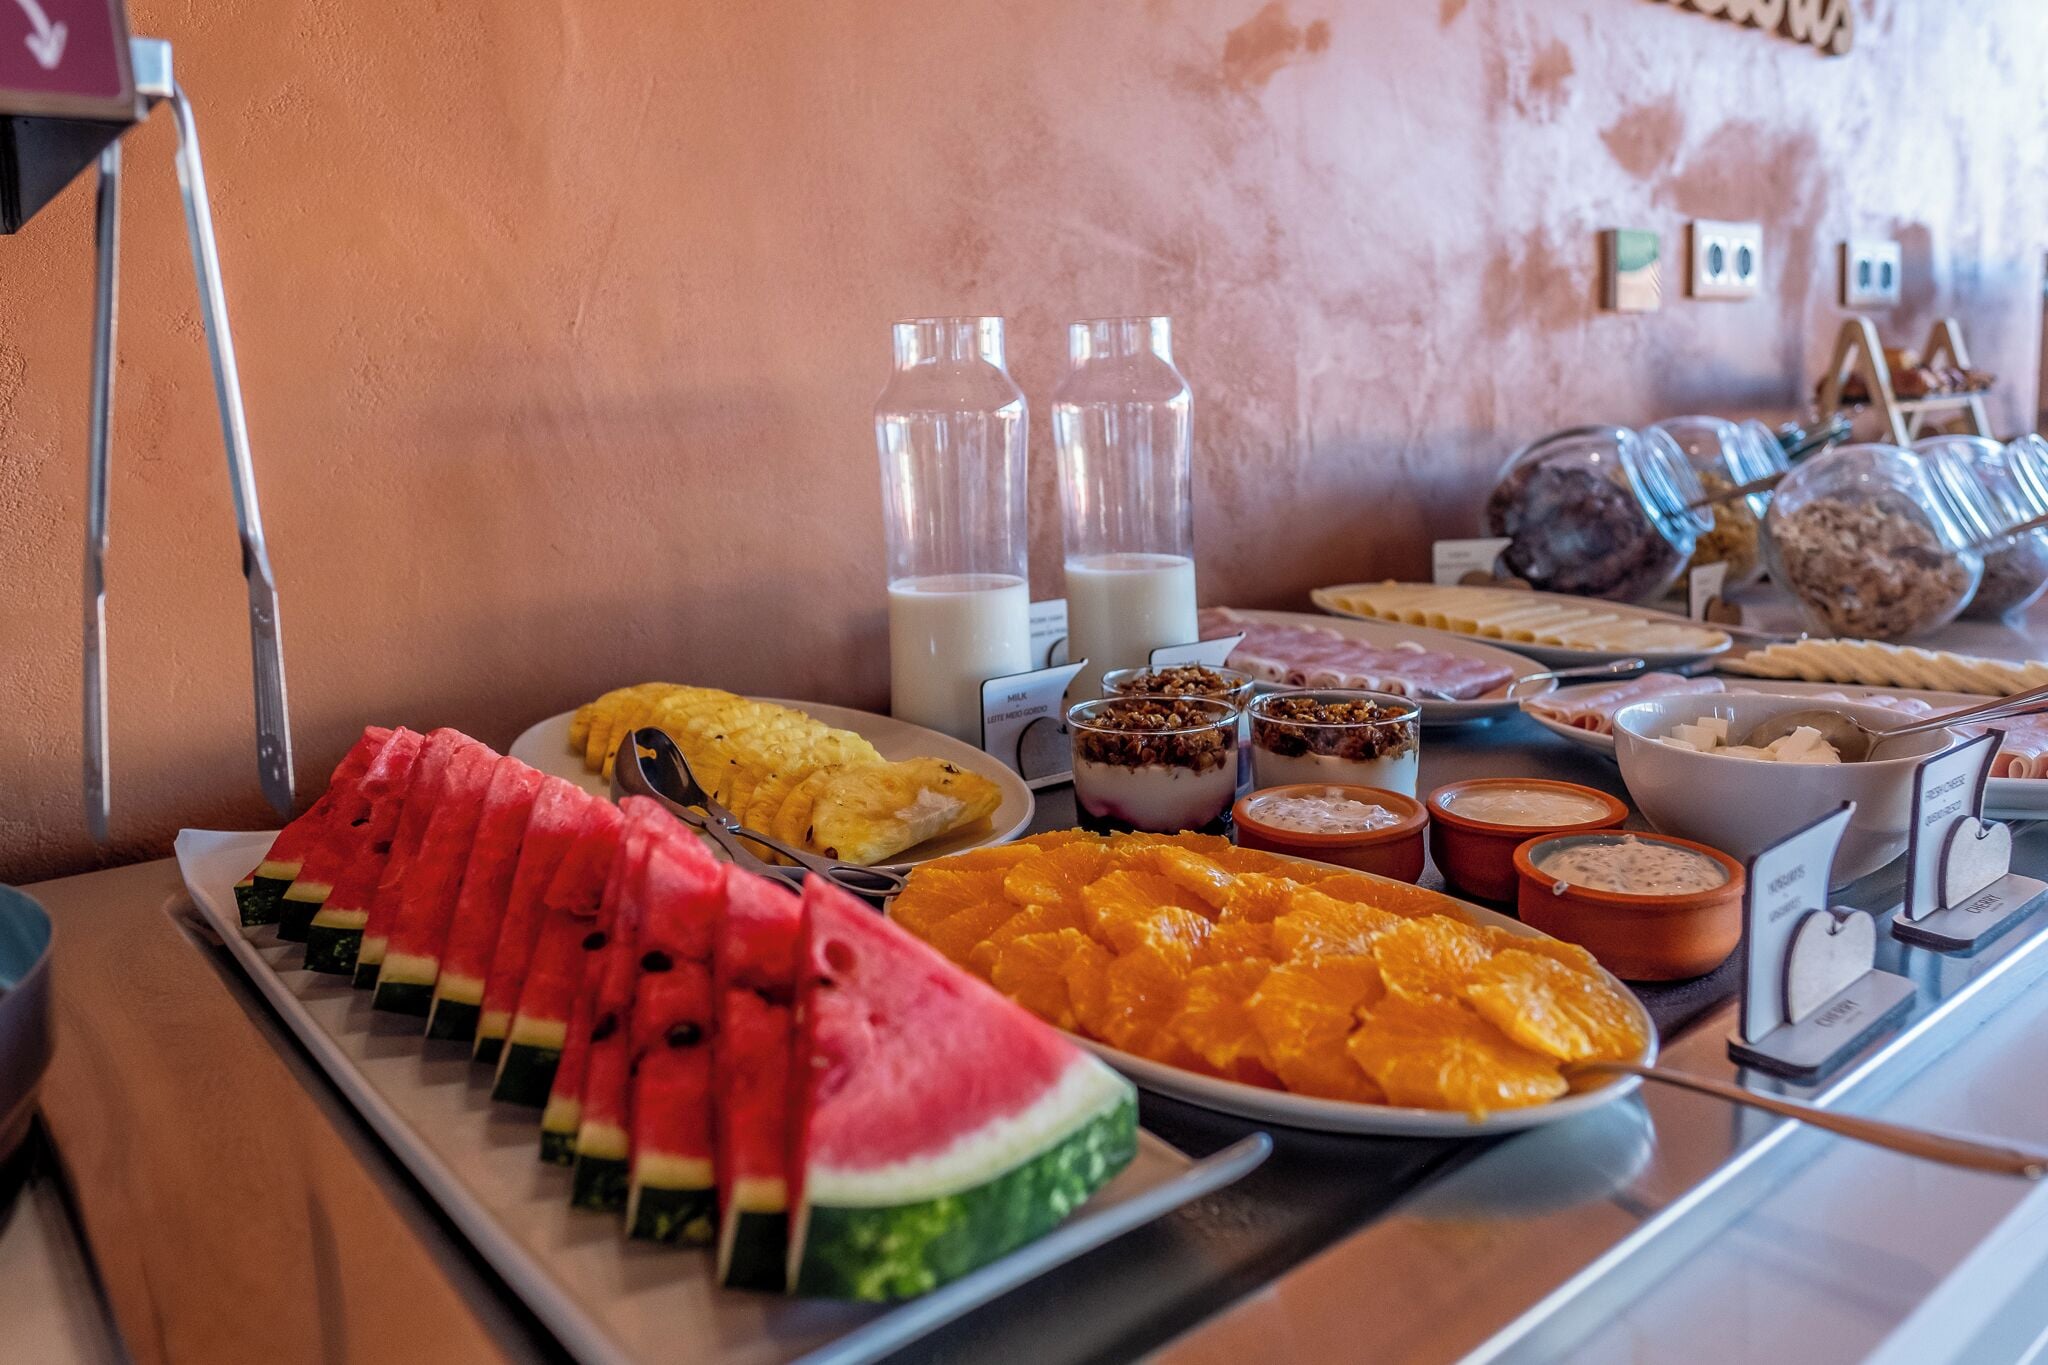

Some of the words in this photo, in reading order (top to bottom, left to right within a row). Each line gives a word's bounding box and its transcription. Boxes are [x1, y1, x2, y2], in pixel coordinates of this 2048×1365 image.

[1007, 692, 1028, 703] MILK
[987, 712, 1005, 724] LEITE
[1005, 710, 1022, 720] MEIO
[1023, 704, 1048, 716] GORDO
[1964, 893, 2001, 914] CHERRY
[1814, 999, 1860, 1028] CHERRY
